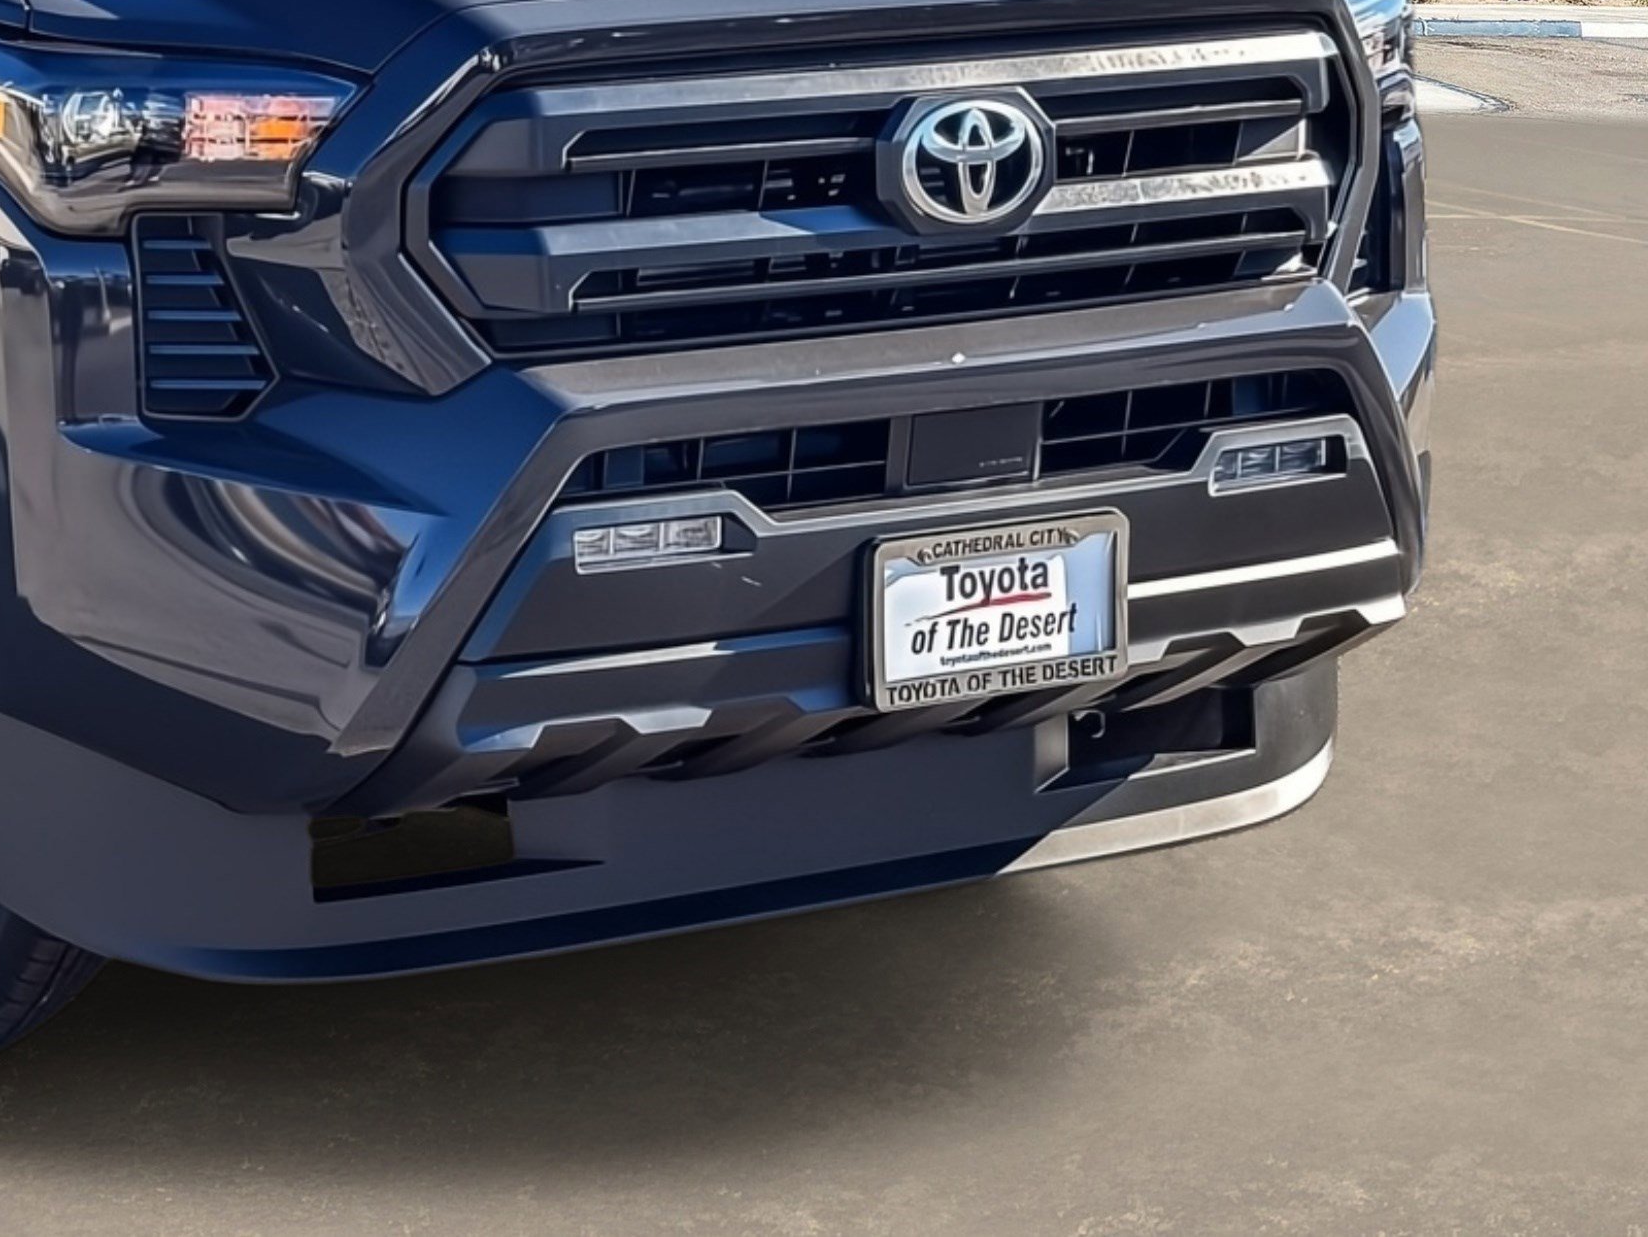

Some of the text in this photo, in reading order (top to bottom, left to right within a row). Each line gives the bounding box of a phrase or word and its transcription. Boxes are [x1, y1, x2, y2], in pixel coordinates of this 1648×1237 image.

[932, 527, 1067, 559] CATHEDRAL CITY
[939, 557, 1049, 605] Toyota
[911, 603, 1077, 655] of The Desert
[886, 655, 1118, 706] TOYOTA OF THE DESERT
